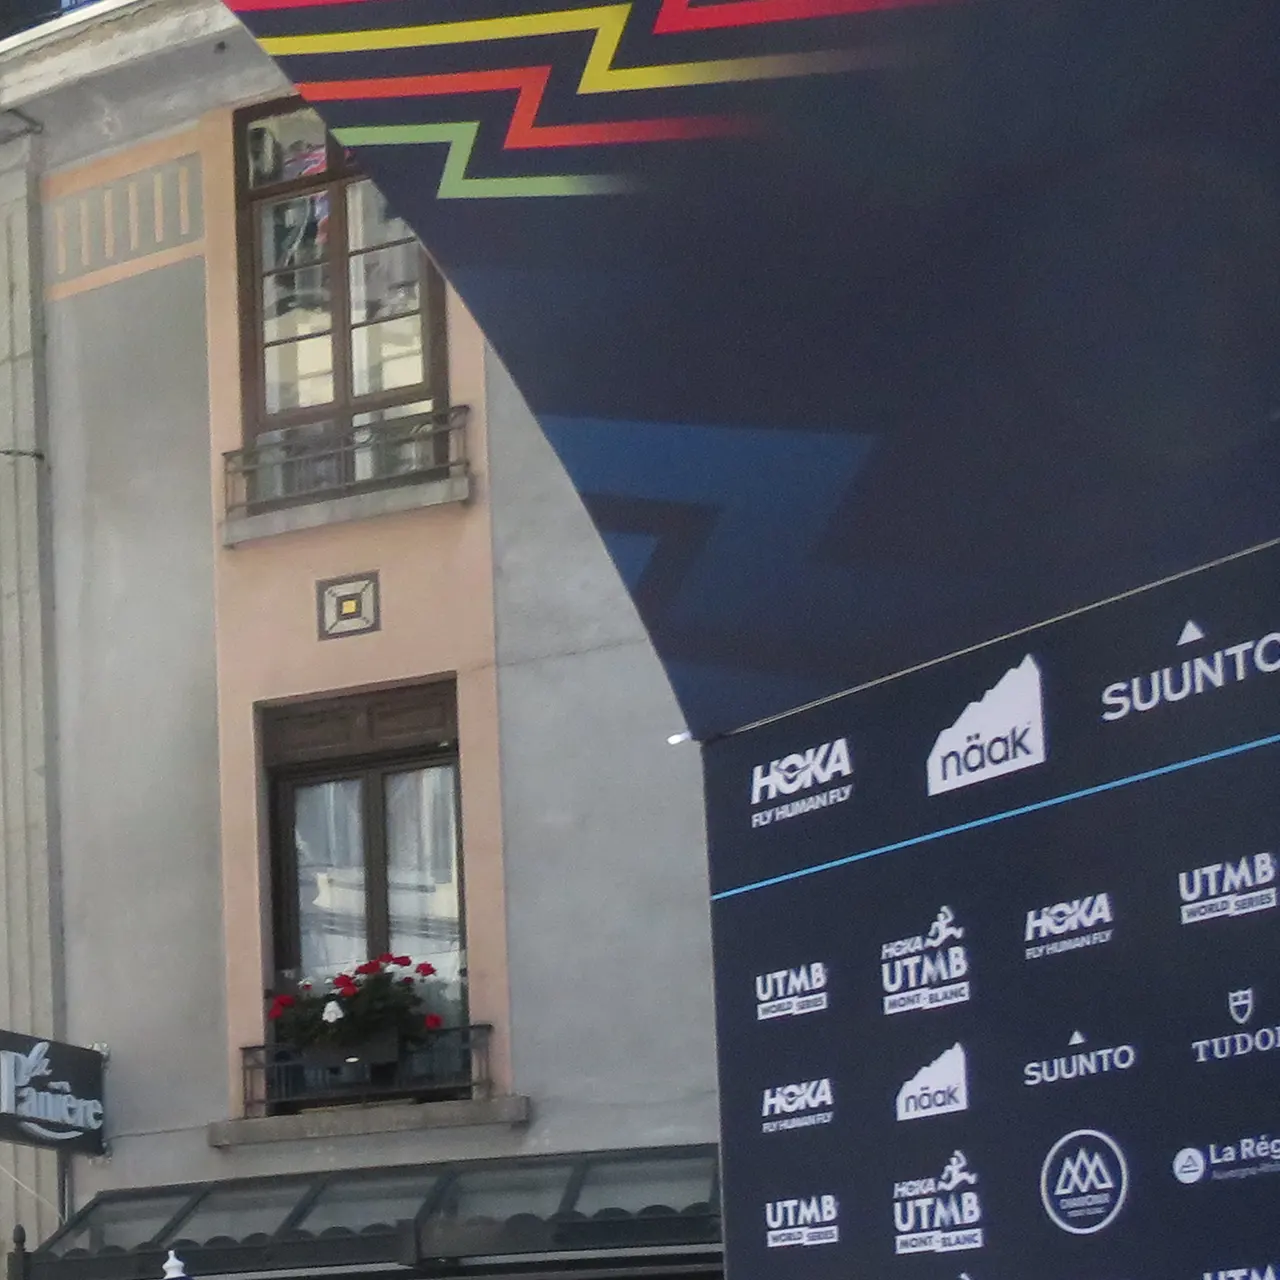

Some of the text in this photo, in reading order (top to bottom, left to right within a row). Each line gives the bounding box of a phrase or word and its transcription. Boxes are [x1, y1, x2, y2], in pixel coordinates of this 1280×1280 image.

[1101, 632, 1280, 721] SUUNTO
[750, 738, 853, 805] HOKA
[941, 726, 1032, 781] näak
[1179, 852, 1276, 901] UTMB
[1024, 893, 1113, 941] HOKA
[881, 936, 924, 959] HOKA
[756, 962, 827, 1001] UTMB
[881, 946, 968, 993] UTMB
[1192, 1026, 1280, 1062] TUDO
[1023, 1045, 1137, 1086] SUUNTO
[762, 1078, 834, 1116] HOKA
[905, 1086, 960, 1113] näak
[1209, 1143, 1235, 1164] La
[893, 1177, 936, 1198] HOKA
[765, 1194, 837, 1228] UTMB
[893, 1192, 981, 1232] UTMB
